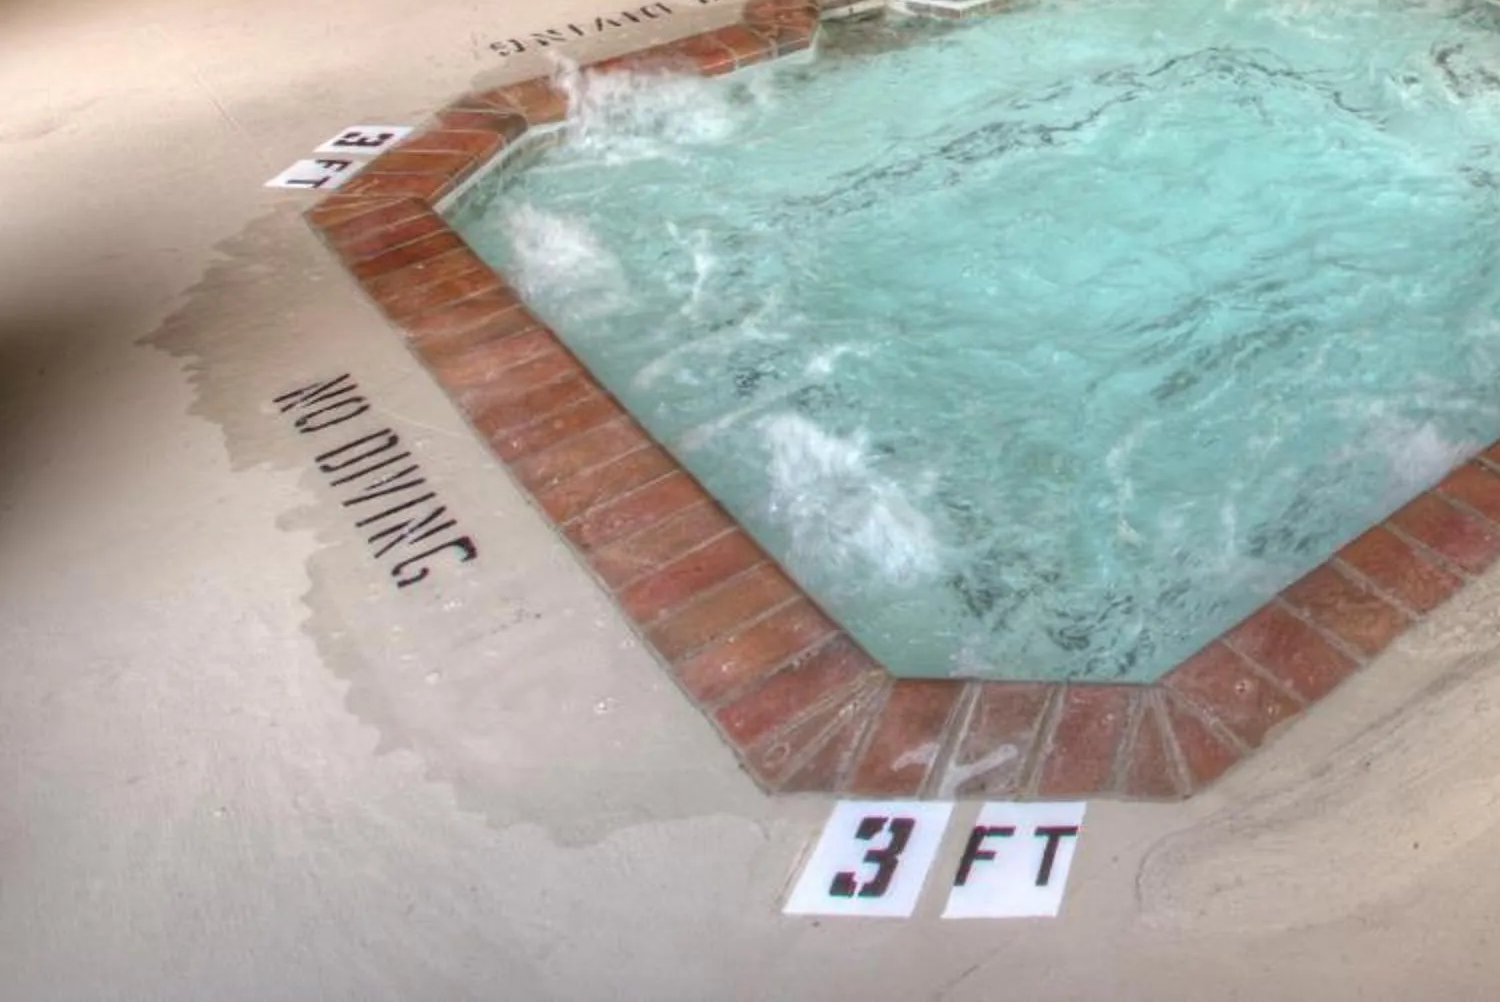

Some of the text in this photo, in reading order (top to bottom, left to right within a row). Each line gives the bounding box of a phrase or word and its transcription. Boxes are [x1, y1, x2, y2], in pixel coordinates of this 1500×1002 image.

[489, 1, 672, 56] DIVING
[286, 131, 395, 188] 3 FT
[272, 372, 478, 588] NO DIVING
[828, 815, 1083, 898] 3 FT
